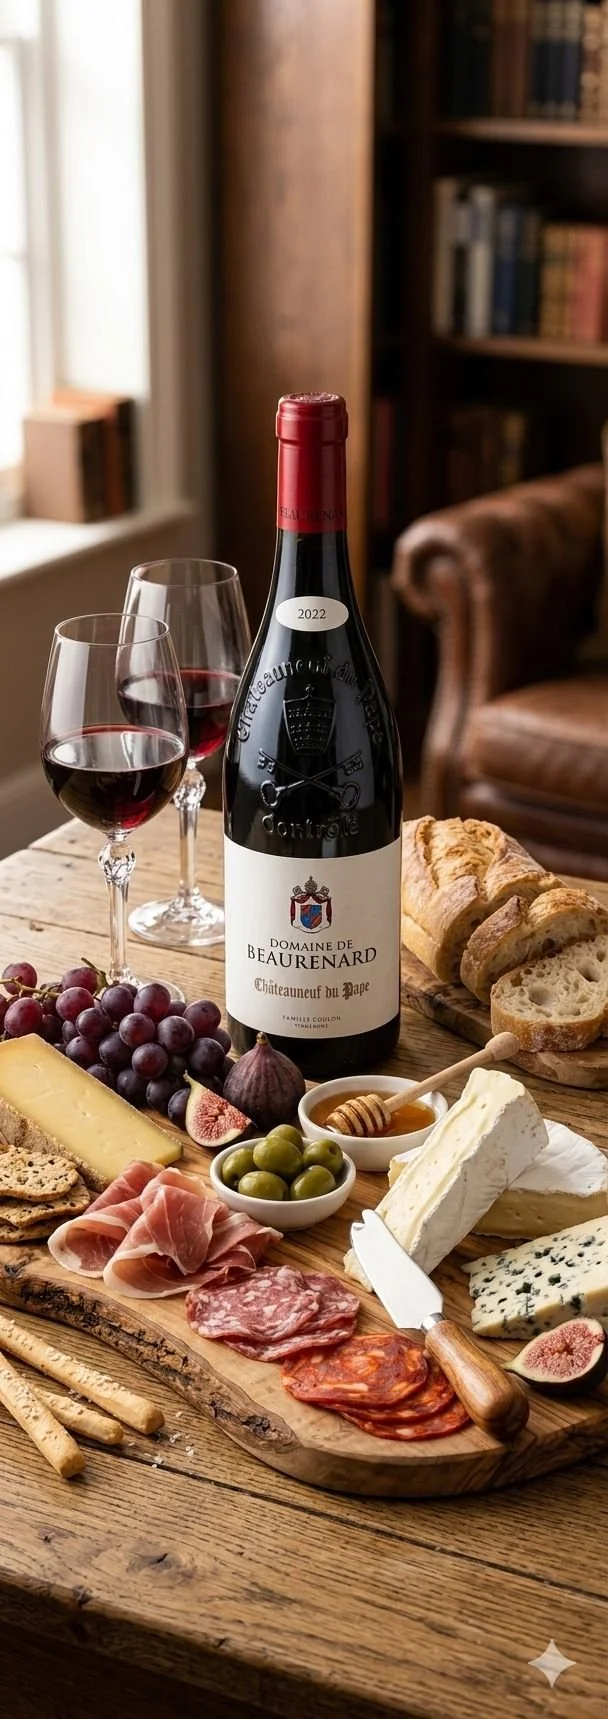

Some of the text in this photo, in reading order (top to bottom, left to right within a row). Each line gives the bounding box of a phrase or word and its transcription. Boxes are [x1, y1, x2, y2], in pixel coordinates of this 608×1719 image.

[297, 608, 327, 620] 2022
[270, 938, 354, 952] DOMAINE DE
[247, 943, 378, 971] BEAURENARD
[254, 977, 370, 1001] Châteauneuf du Pape
[282, 1015, 341, 1023] FAMILLE COULON
